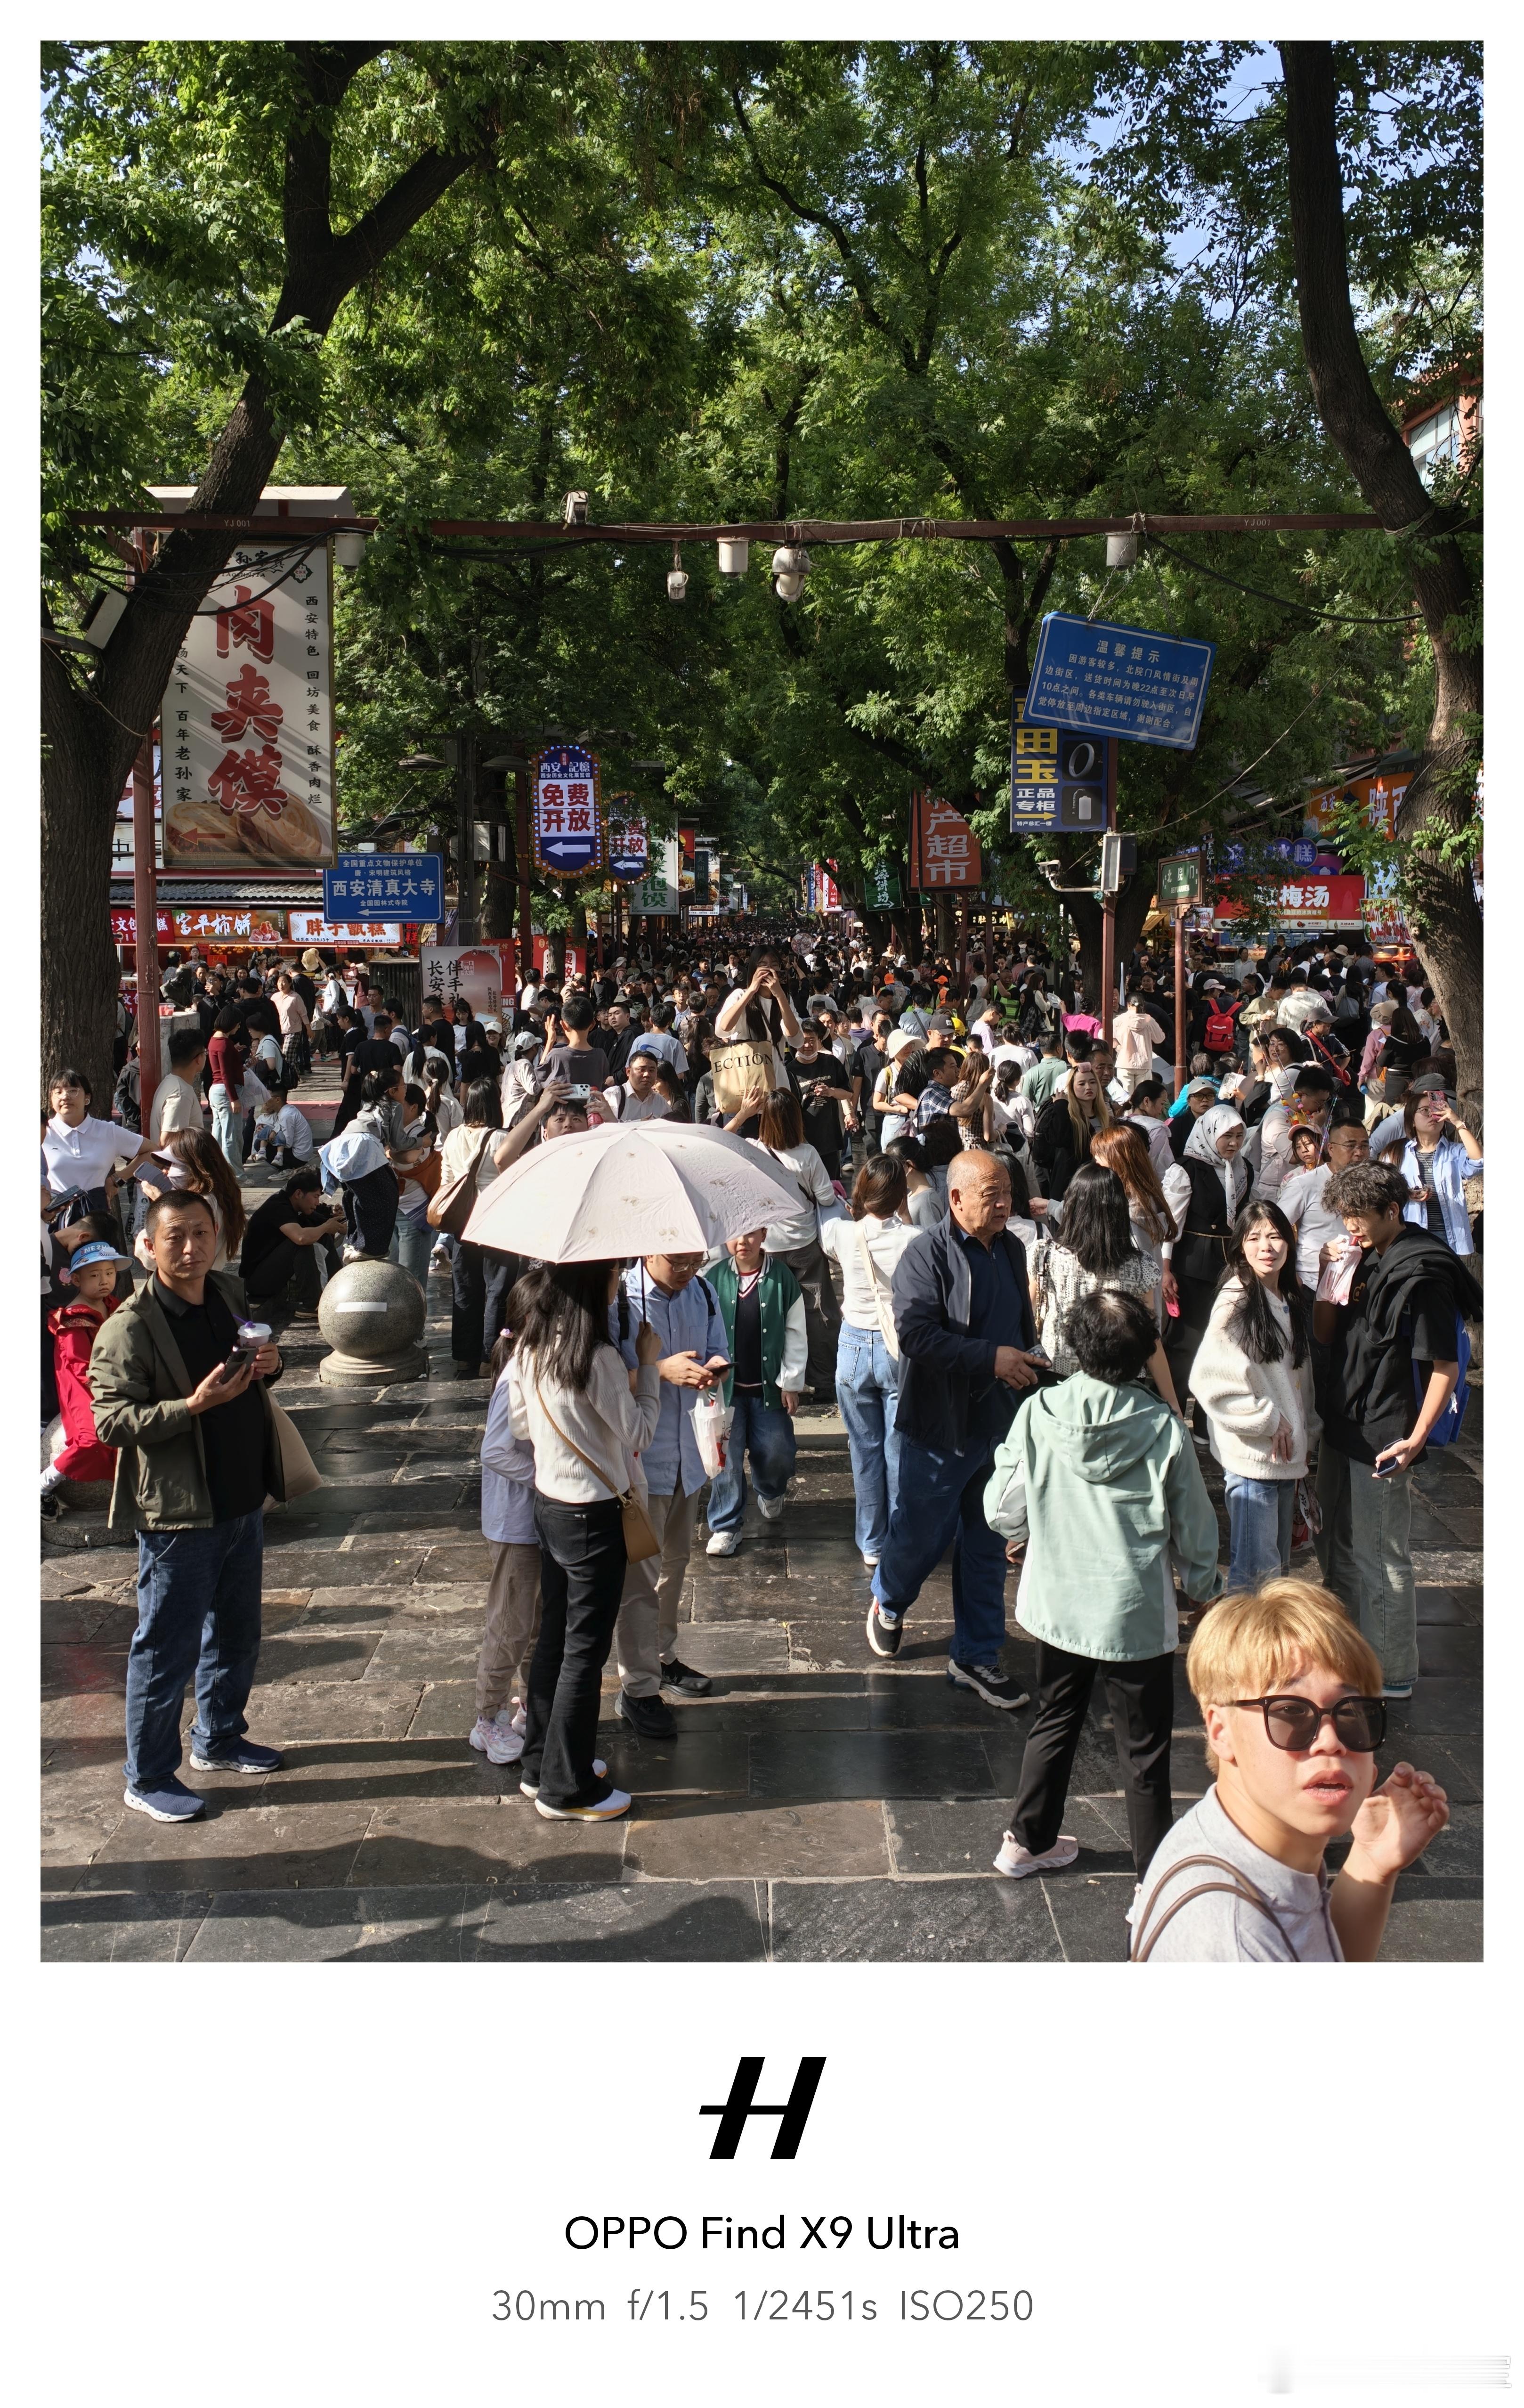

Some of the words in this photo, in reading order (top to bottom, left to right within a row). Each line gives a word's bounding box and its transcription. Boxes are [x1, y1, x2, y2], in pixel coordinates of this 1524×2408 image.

[224, 520, 235, 528] YJ
[305, 596, 320, 657] 西安特色
[1096, 639, 1160, 663] 温馨提示
[208, 585, 289, 821] 肉夹馍
[307, 670, 321, 732] 回坊美食
[174, 710, 192, 802] 百年老孙家
[307, 745, 323, 805] 酥香肉烂
[542, 783, 589, 807] 免费
[1016, 788, 1055, 799] 正品
[1016, 800, 1055, 811] 专柜
[543, 808, 591, 833] 开放
[342, 859, 423, 868] 全国重点文物保护单位
[1167, 865, 1195, 883] 北院门
[331, 879, 436, 897] 西安清真大寺
[641, 874, 668, 908] 泡馍
